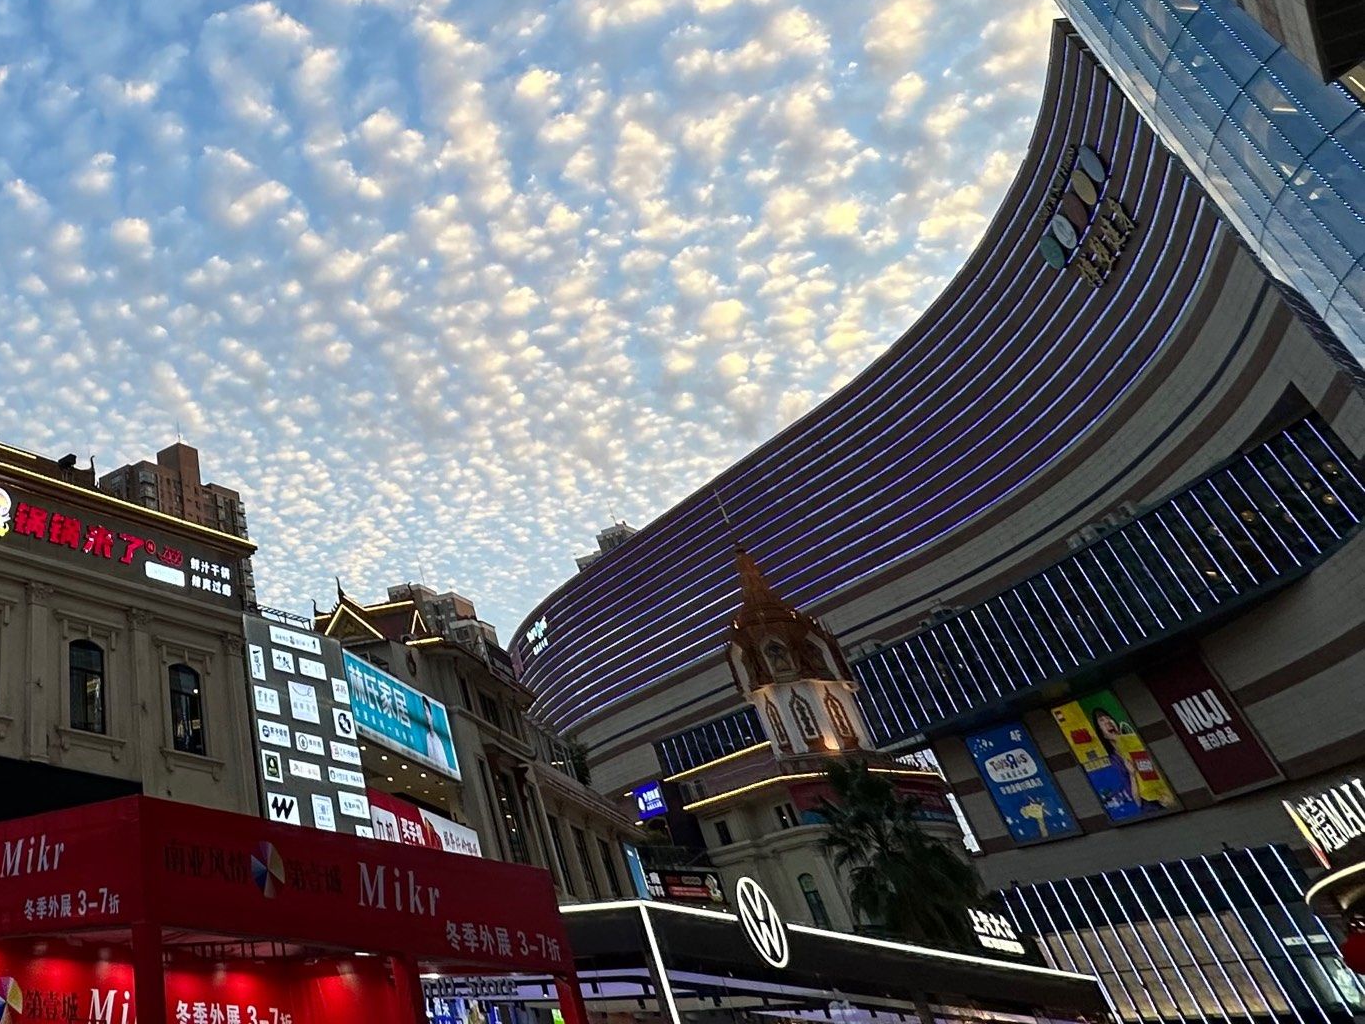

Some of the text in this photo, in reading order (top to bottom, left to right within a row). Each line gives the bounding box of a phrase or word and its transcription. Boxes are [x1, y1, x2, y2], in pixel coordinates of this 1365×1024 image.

[14, 502, 144, 565] 锅锅来了
[190, 557, 231, 580] 鲜汁干锅
[347, 662, 412, 729] 林氏家居
[1172, 688, 1232, 735] MUJI
[0, 834, 65, 878] Mikr
[24, 893, 72, 921] 冬季外展
[357, 861, 441, 916] Mikr
[446, 919, 513, 958] 冬季外展
